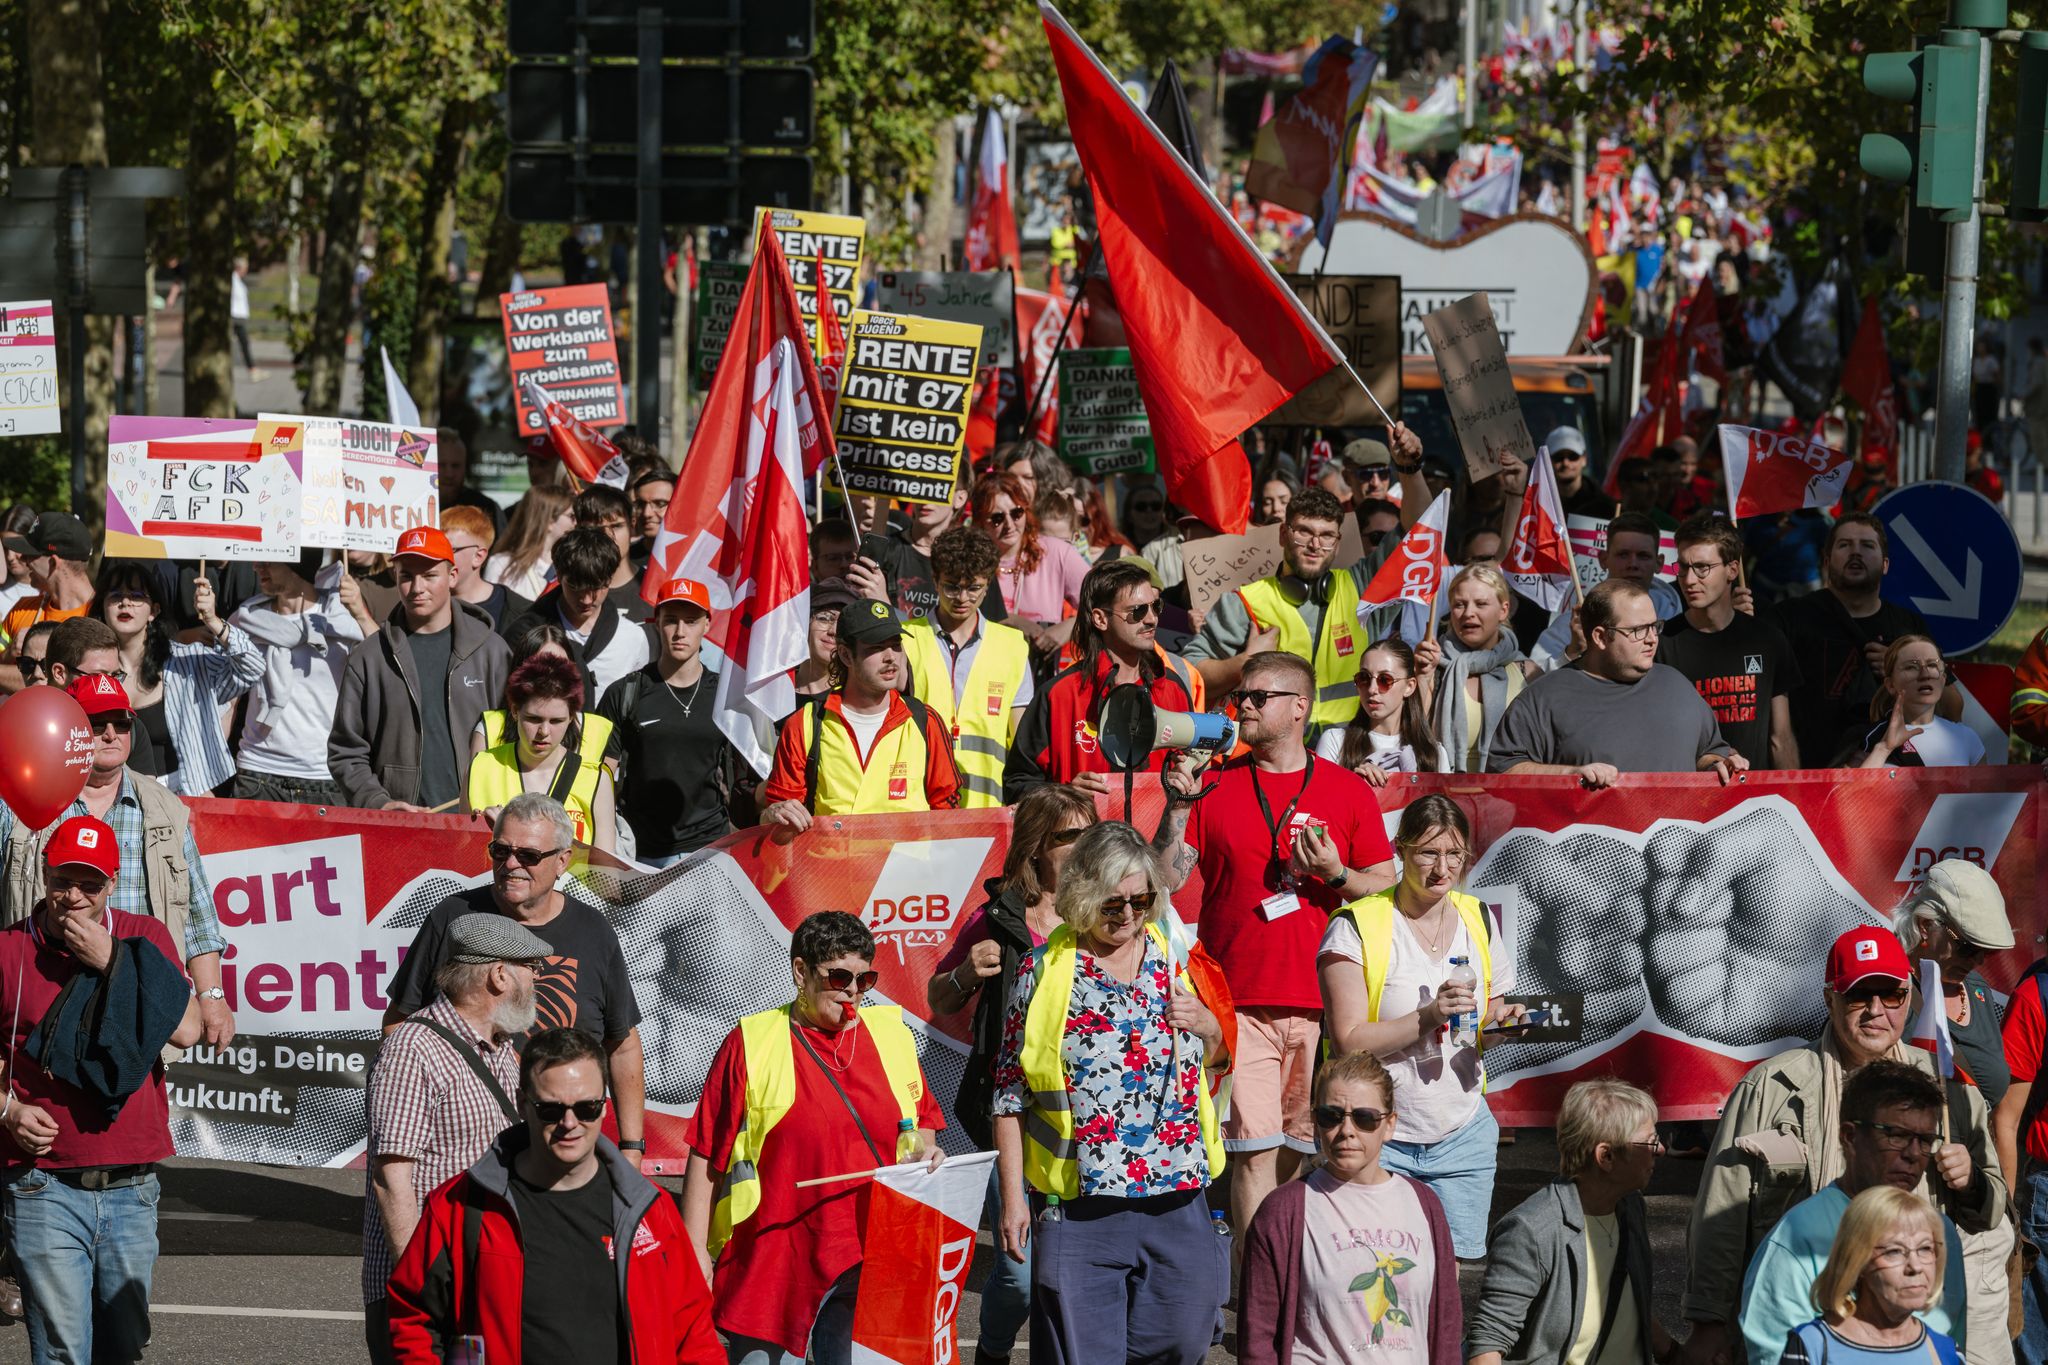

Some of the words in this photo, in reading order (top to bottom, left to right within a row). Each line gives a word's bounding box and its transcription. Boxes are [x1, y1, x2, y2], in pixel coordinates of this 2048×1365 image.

[822, 265, 853, 289] 67
[900, 283, 931, 306] 45
[938, 283, 993, 307] Jahre
[1296, 283, 1375, 327] NDE
[16, 317, 37, 326] FCK
[16, 325, 38, 335] AFD
[513, 312, 558, 331] Von
[564, 308, 602, 326] der
[857, 324, 901, 335] JUGEND
[870, 315, 895, 325] IGBCE
[512, 327, 608, 351] Werkbank
[545, 347, 587, 362] zum
[857, 339, 972, 375] RENTE
[518, 361, 615, 386] Arbeitsamt
[1073, 367, 1137, 383] DANKE
[847, 374, 909, 404] mit
[918, 381, 964, 410] 67
[1076, 388, 1102, 400] für
[1107, 386, 1133, 399] die
[529, 402, 617, 427] SERN!
[842, 408, 882, 436] ist
[890, 413, 956, 442] kein
[350, 423, 392, 452] DOCH
[1065, 424, 1092, 435] Wir
[1096, 422, 1147, 435] hätten
[837, 442, 952, 473] Princess
[1069, 440, 1104, 454] gern
[163, 463, 251, 494] FCK
[835, 468, 950, 499] Treatment!
[152, 495, 243, 521] AFD
[1189, 554, 1216, 576] Es
[1198, 571, 1231, 602] gibt
[1225, 546, 1260, 571] kein
[1400, 532, 1436, 600] DGB
[905, 590, 940, 606] WISH
[1696, 674, 1756, 696] LIONEN
[1706, 694, 1737, 707] RKER
[1739, 693, 1757, 704] ALS
[70, 726, 90, 740] Nach
[64, 740, 72, 752] 8
[213, 855, 342, 928] art
[873, 894, 950, 925] DGB
[220, 943, 411, 1013] ient
[177, 1045, 266, 1075] ung.
[274, 1045, 365, 1073] Deine
[1330, 1228, 1421, 1256] LEMON
[934, 1236, 972, 1365] DGB
